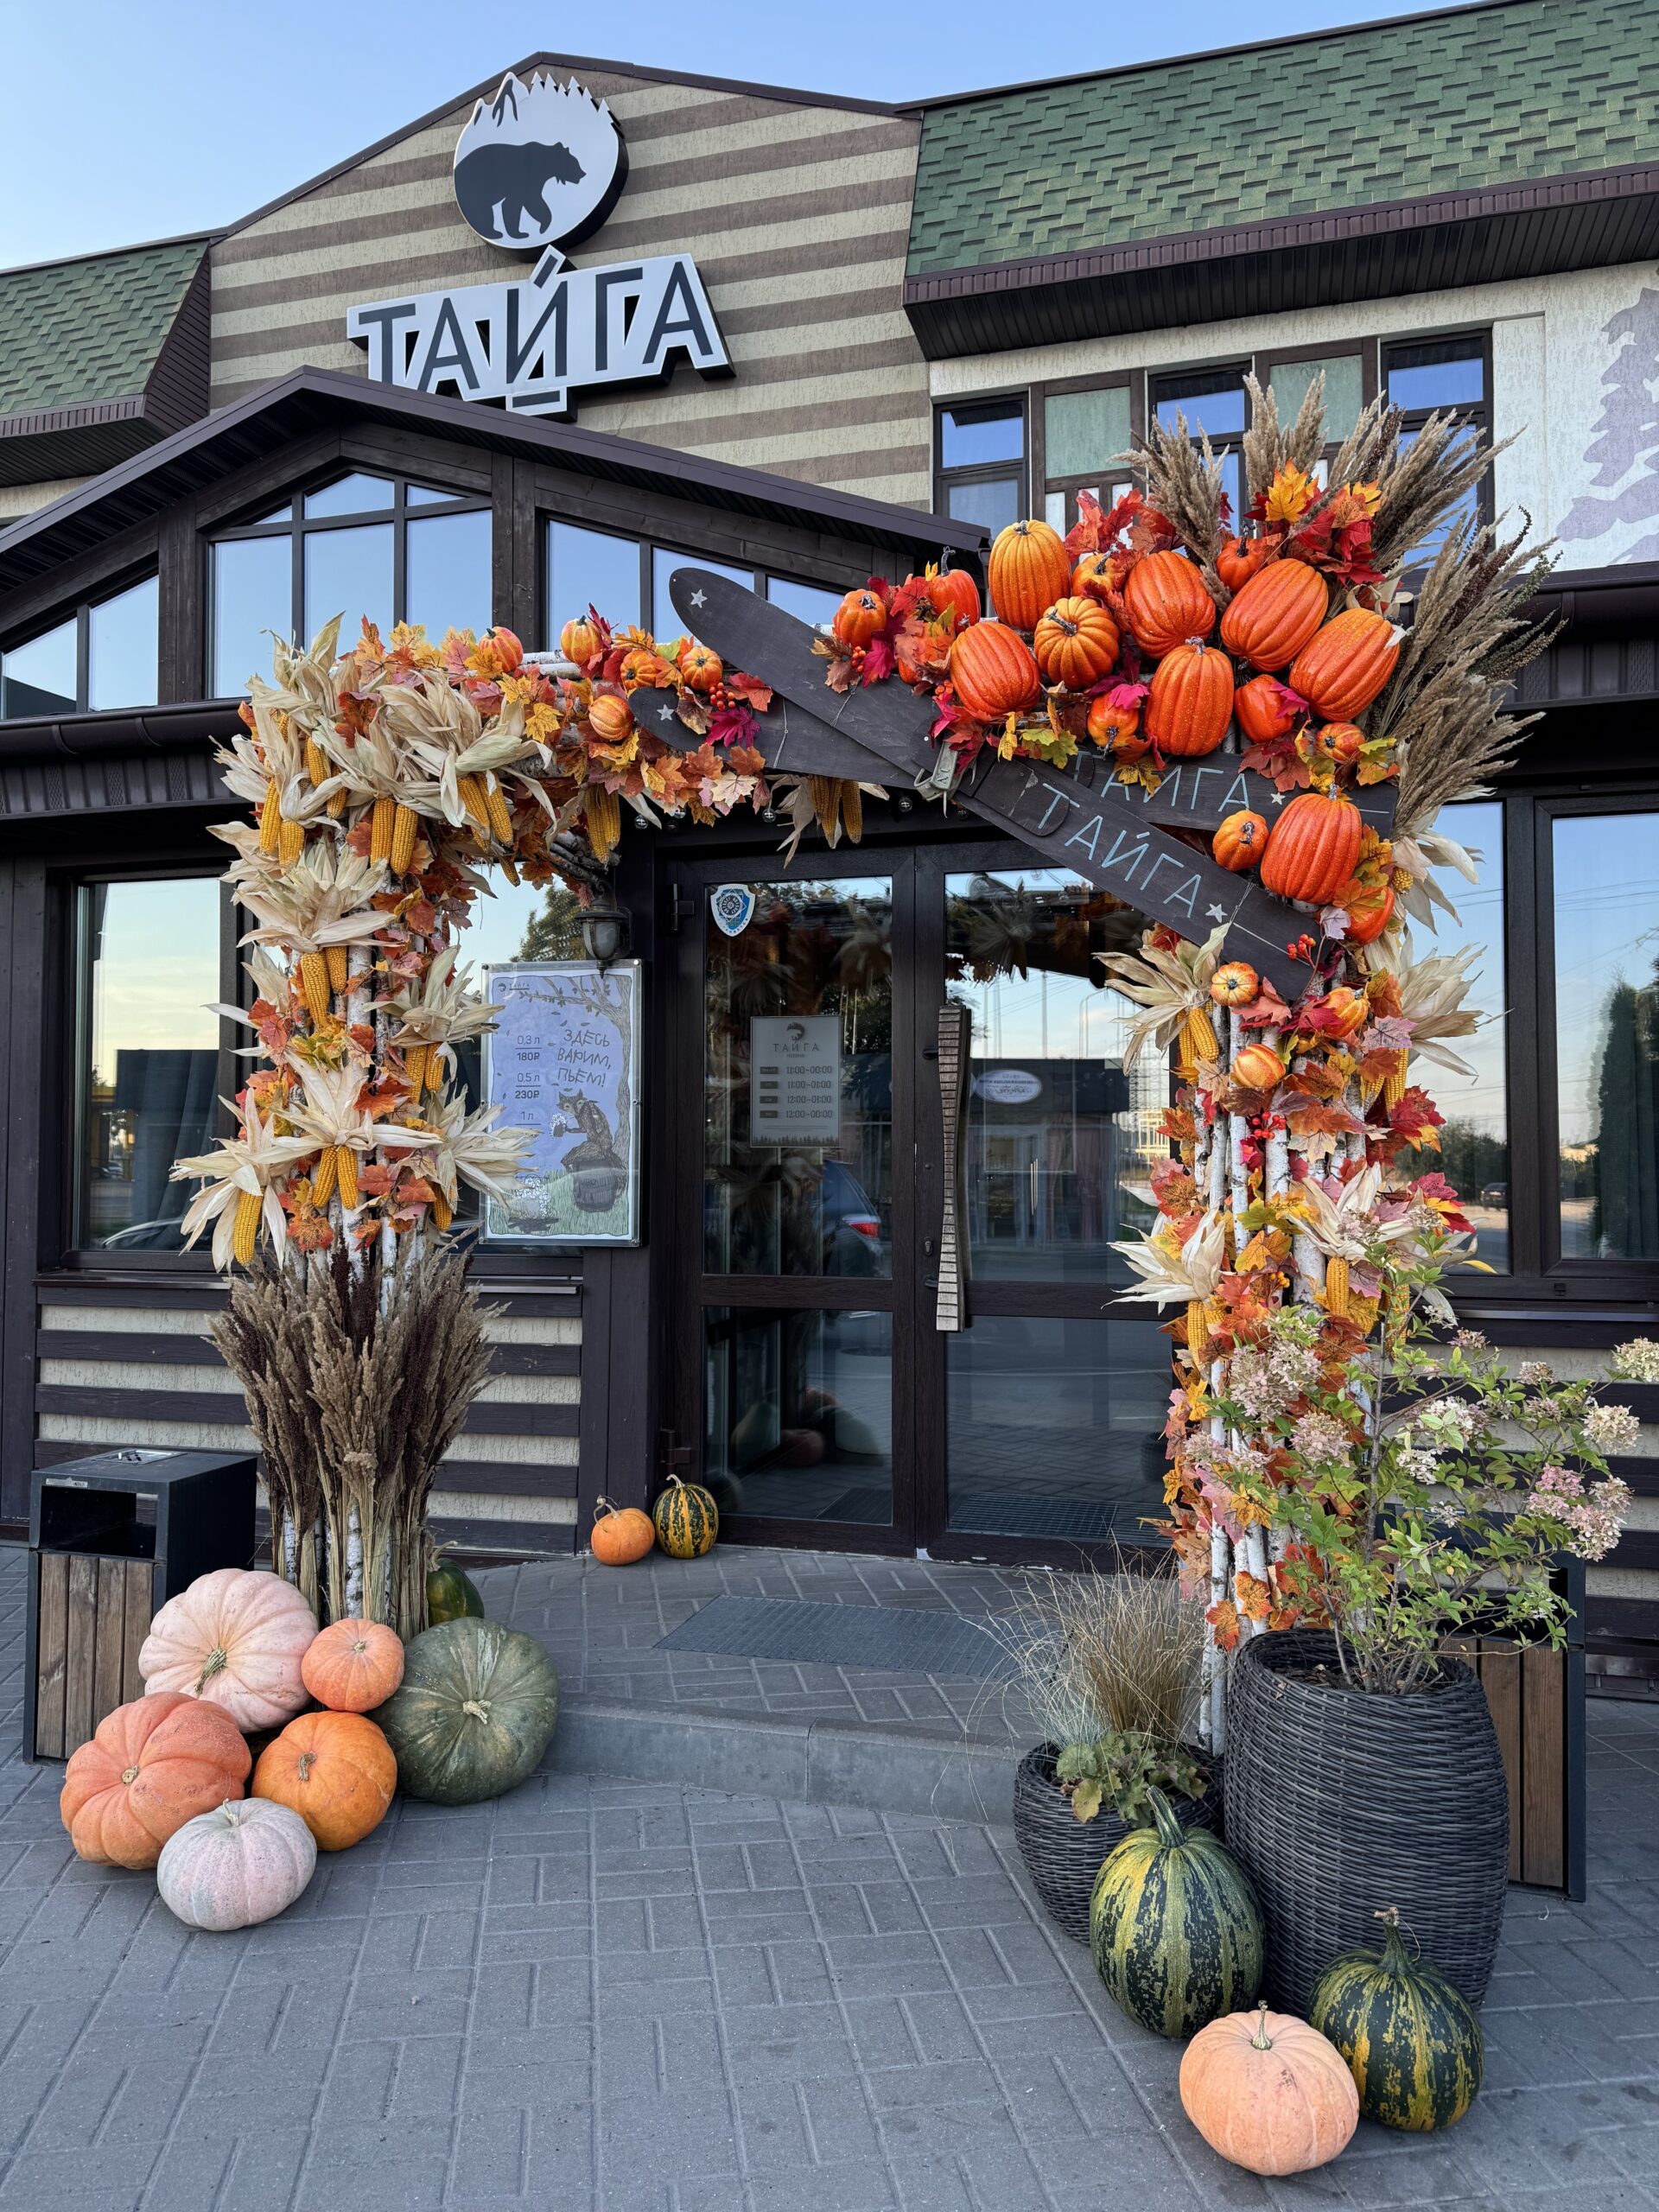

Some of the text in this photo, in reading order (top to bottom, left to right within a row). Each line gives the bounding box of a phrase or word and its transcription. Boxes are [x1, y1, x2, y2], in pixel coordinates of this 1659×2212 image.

[359, 254, 714, 391] ТАЙГА
[1037, 783, 1202, 918] ТАЙГА
[517, 1035, 540, 1046] 0,3 л
[563, 1029, 610, 1047] ЗДЕСЬ
[772, 1041, 819, 1052] ТАЙГА
[557, 1047, 611, 1070] ВАРИМ,
[517, 1073, 532, 1084] 0,5
[558, 1068, 606, 1088] ПЬЕМ!
